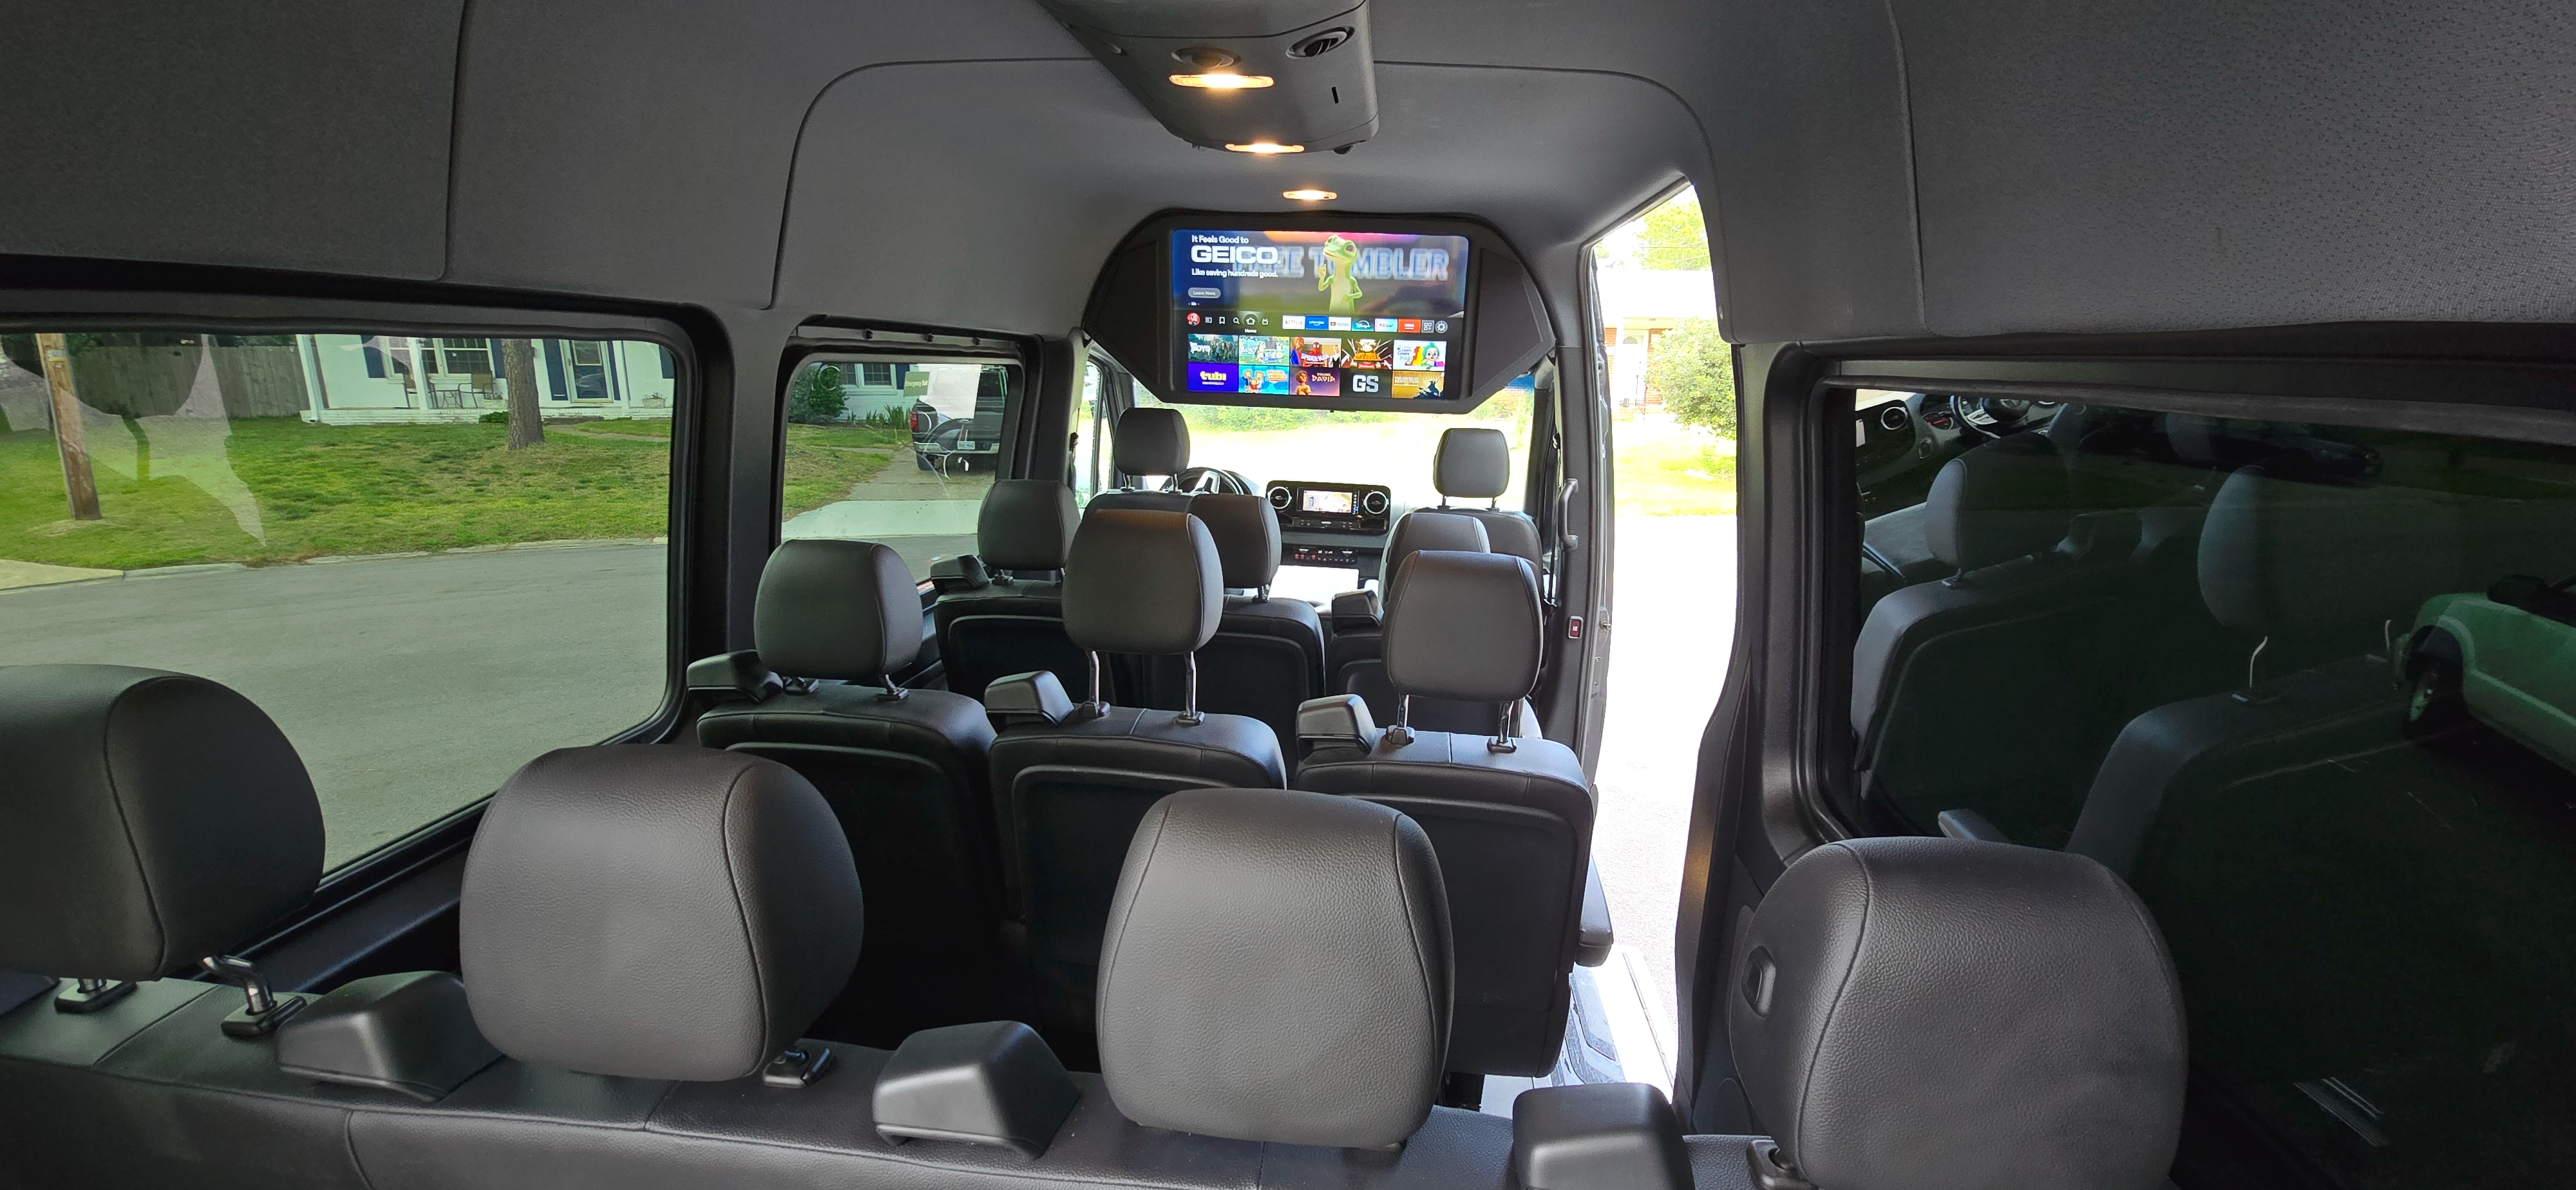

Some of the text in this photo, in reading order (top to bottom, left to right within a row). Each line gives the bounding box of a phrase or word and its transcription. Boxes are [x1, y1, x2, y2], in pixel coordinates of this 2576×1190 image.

[1191, 234, 1198, 243] It
[1218, 235, 1240, 244] Good
[1191, 245, 1279, 265] GEICO
[1206, 269, 1227, 278] saving
[1227, 269, 1259, 278] hundreds
[1259, 270, 1279, 279] good.
[1200, 371, 1227, 381] tubi
[1311, 374, 1336, 382] DAVID
[1352, 374, 1379, 393] GS
